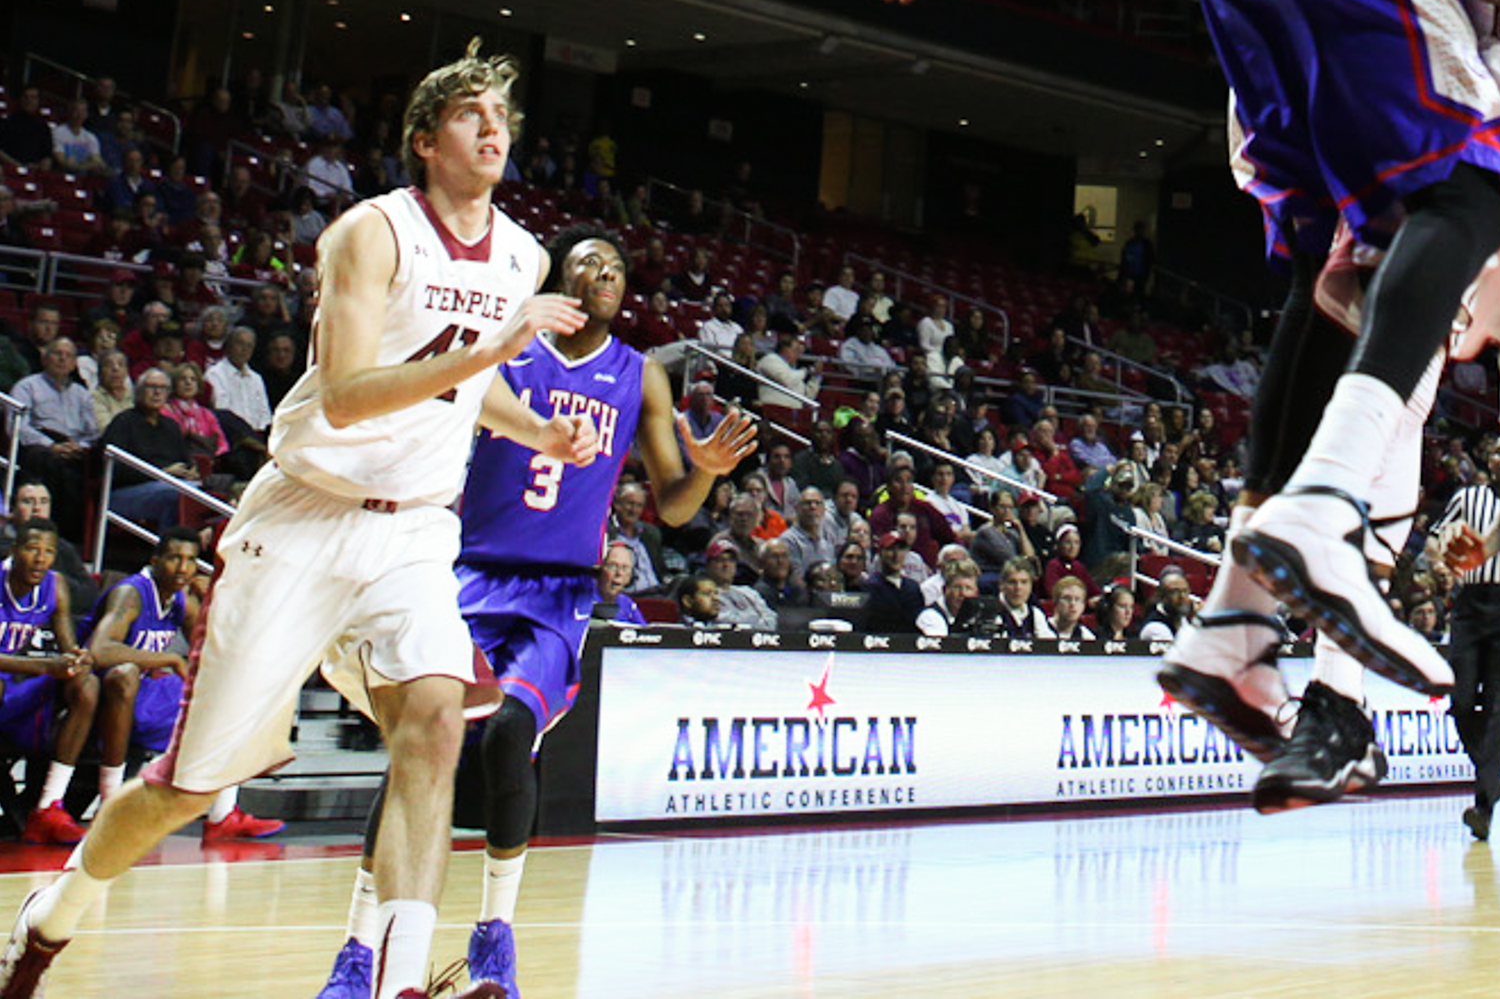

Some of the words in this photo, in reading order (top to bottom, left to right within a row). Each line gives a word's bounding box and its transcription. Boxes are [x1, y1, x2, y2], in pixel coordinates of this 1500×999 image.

[424, 284, 508, 321] TEMPLE
[522, 452, 567, 512] 3
[667, 716, 918, 782] AMERICAN
[1372, 709, 1462, 756] MERIC
[666, 792, 772, 813] ATHLETIC
[785, 786, 916, 808] CONFERENCE
[1056, 777, 1135, 797] ATHLETIC
[1144, 772, 1244, 792] CONFERENCE
